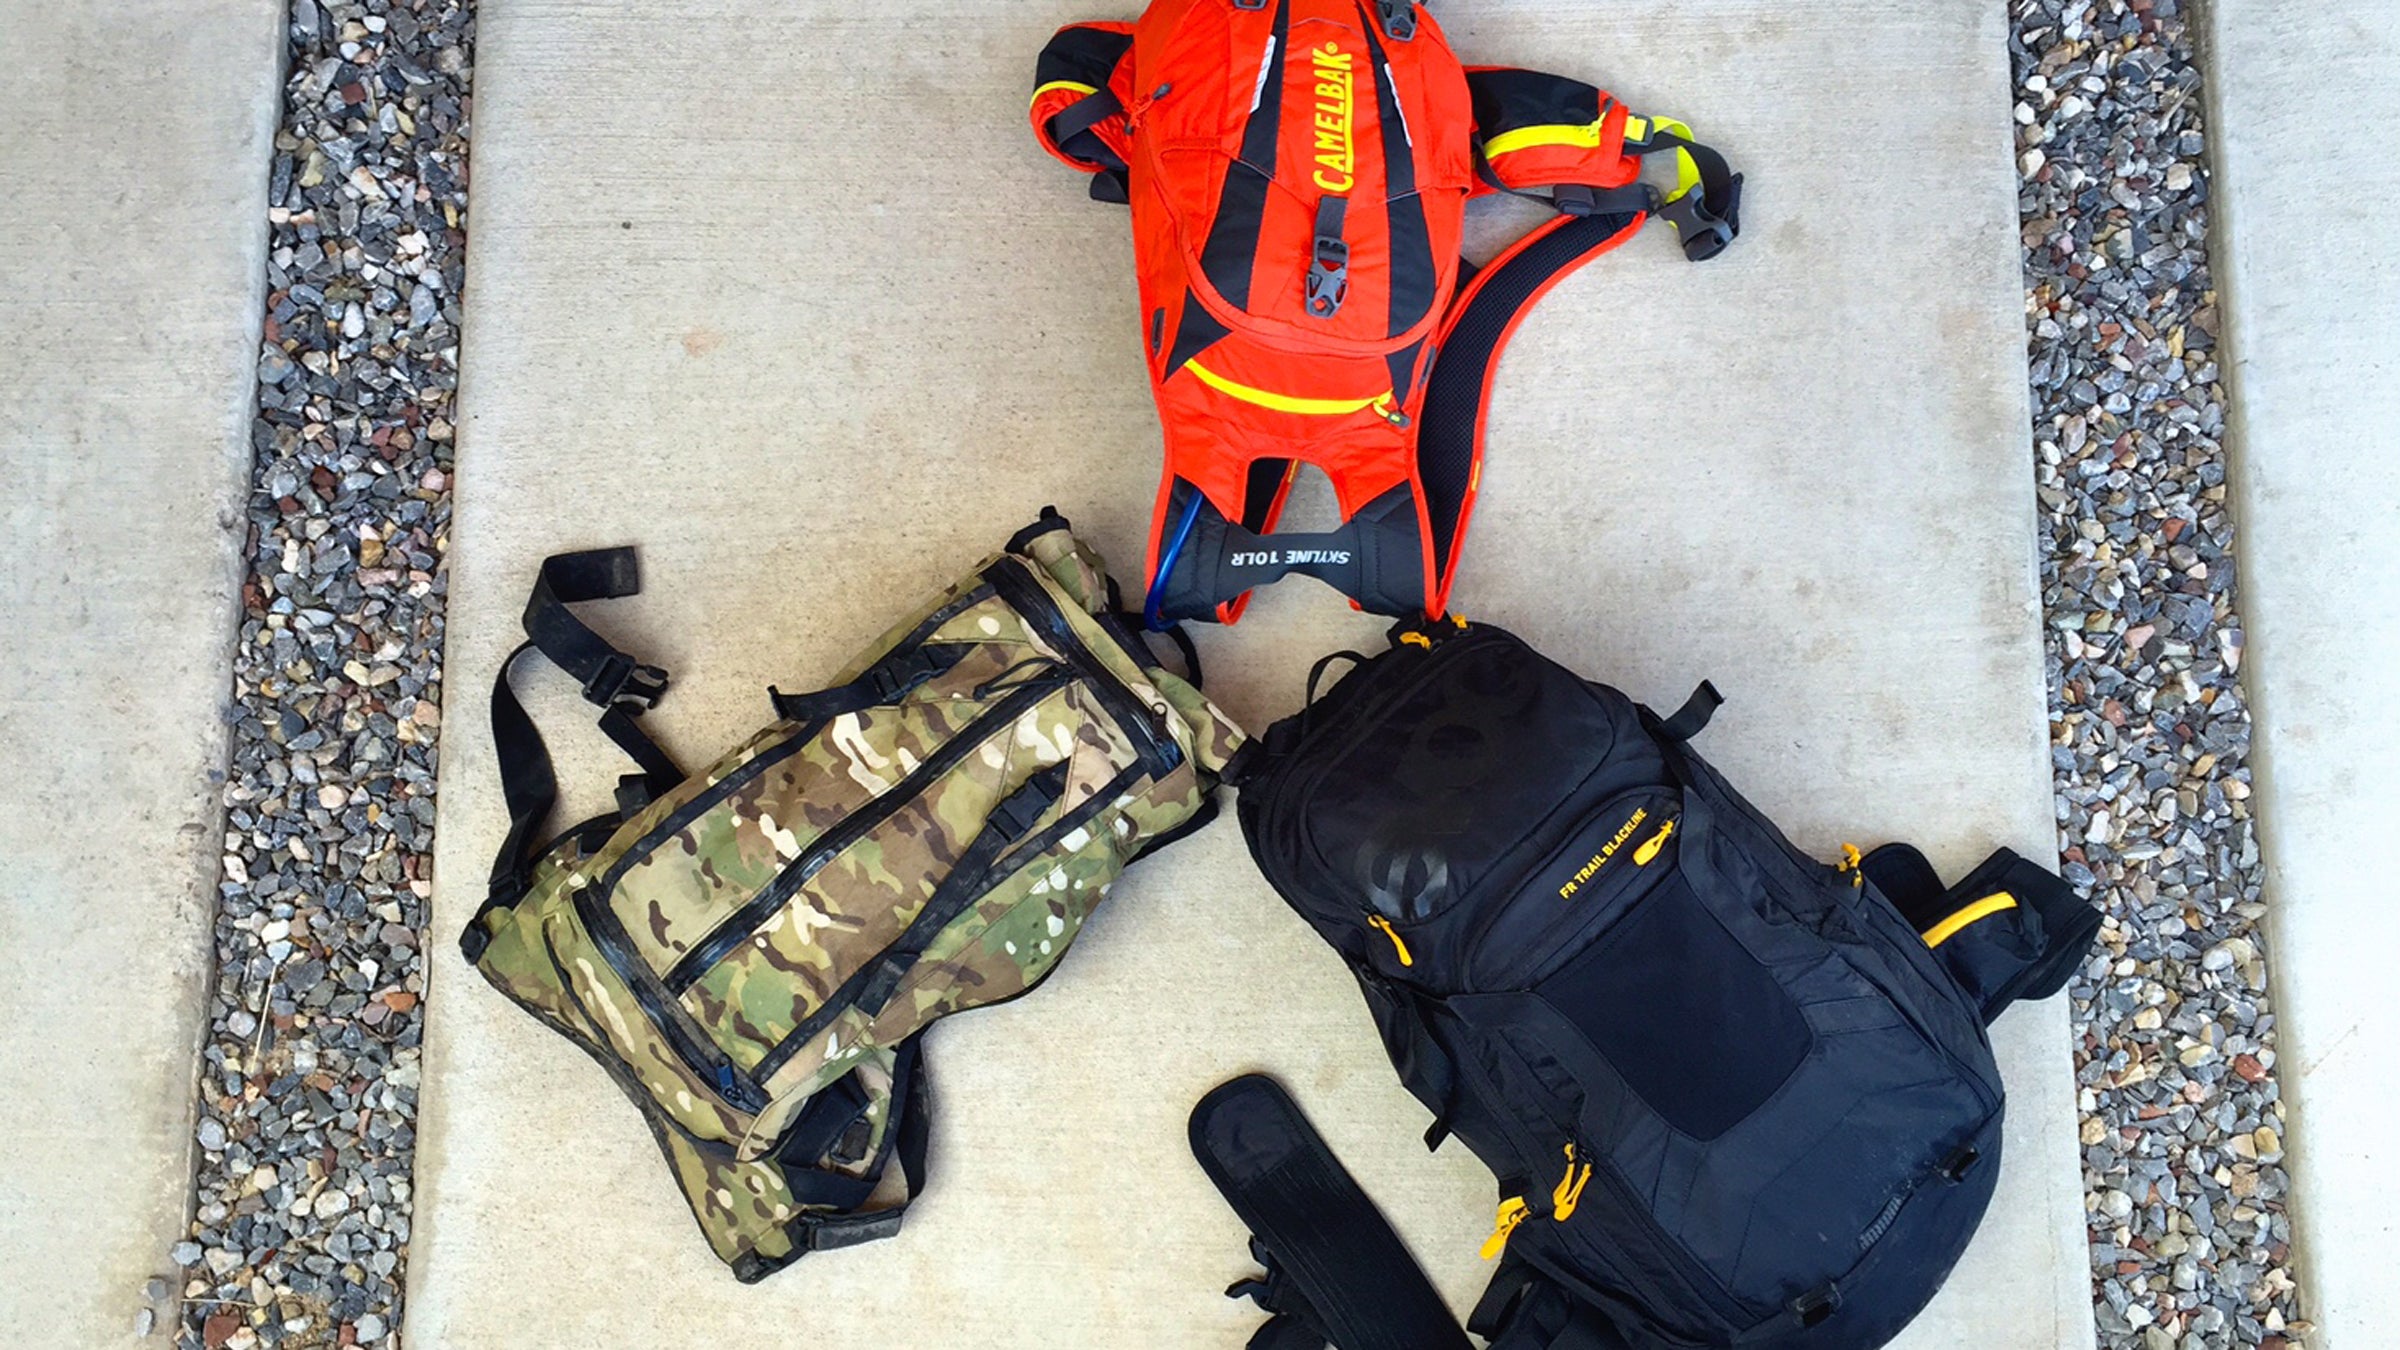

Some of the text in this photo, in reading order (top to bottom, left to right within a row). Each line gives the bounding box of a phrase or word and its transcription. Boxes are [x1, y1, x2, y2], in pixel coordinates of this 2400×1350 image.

[1312, 47, 1354, 192] CAMELBAK
[1231, 550, 1352, 566] SKYLINE 10LR
[1559, 807, 1648, 899] FR TRAIL BLACKLINE
